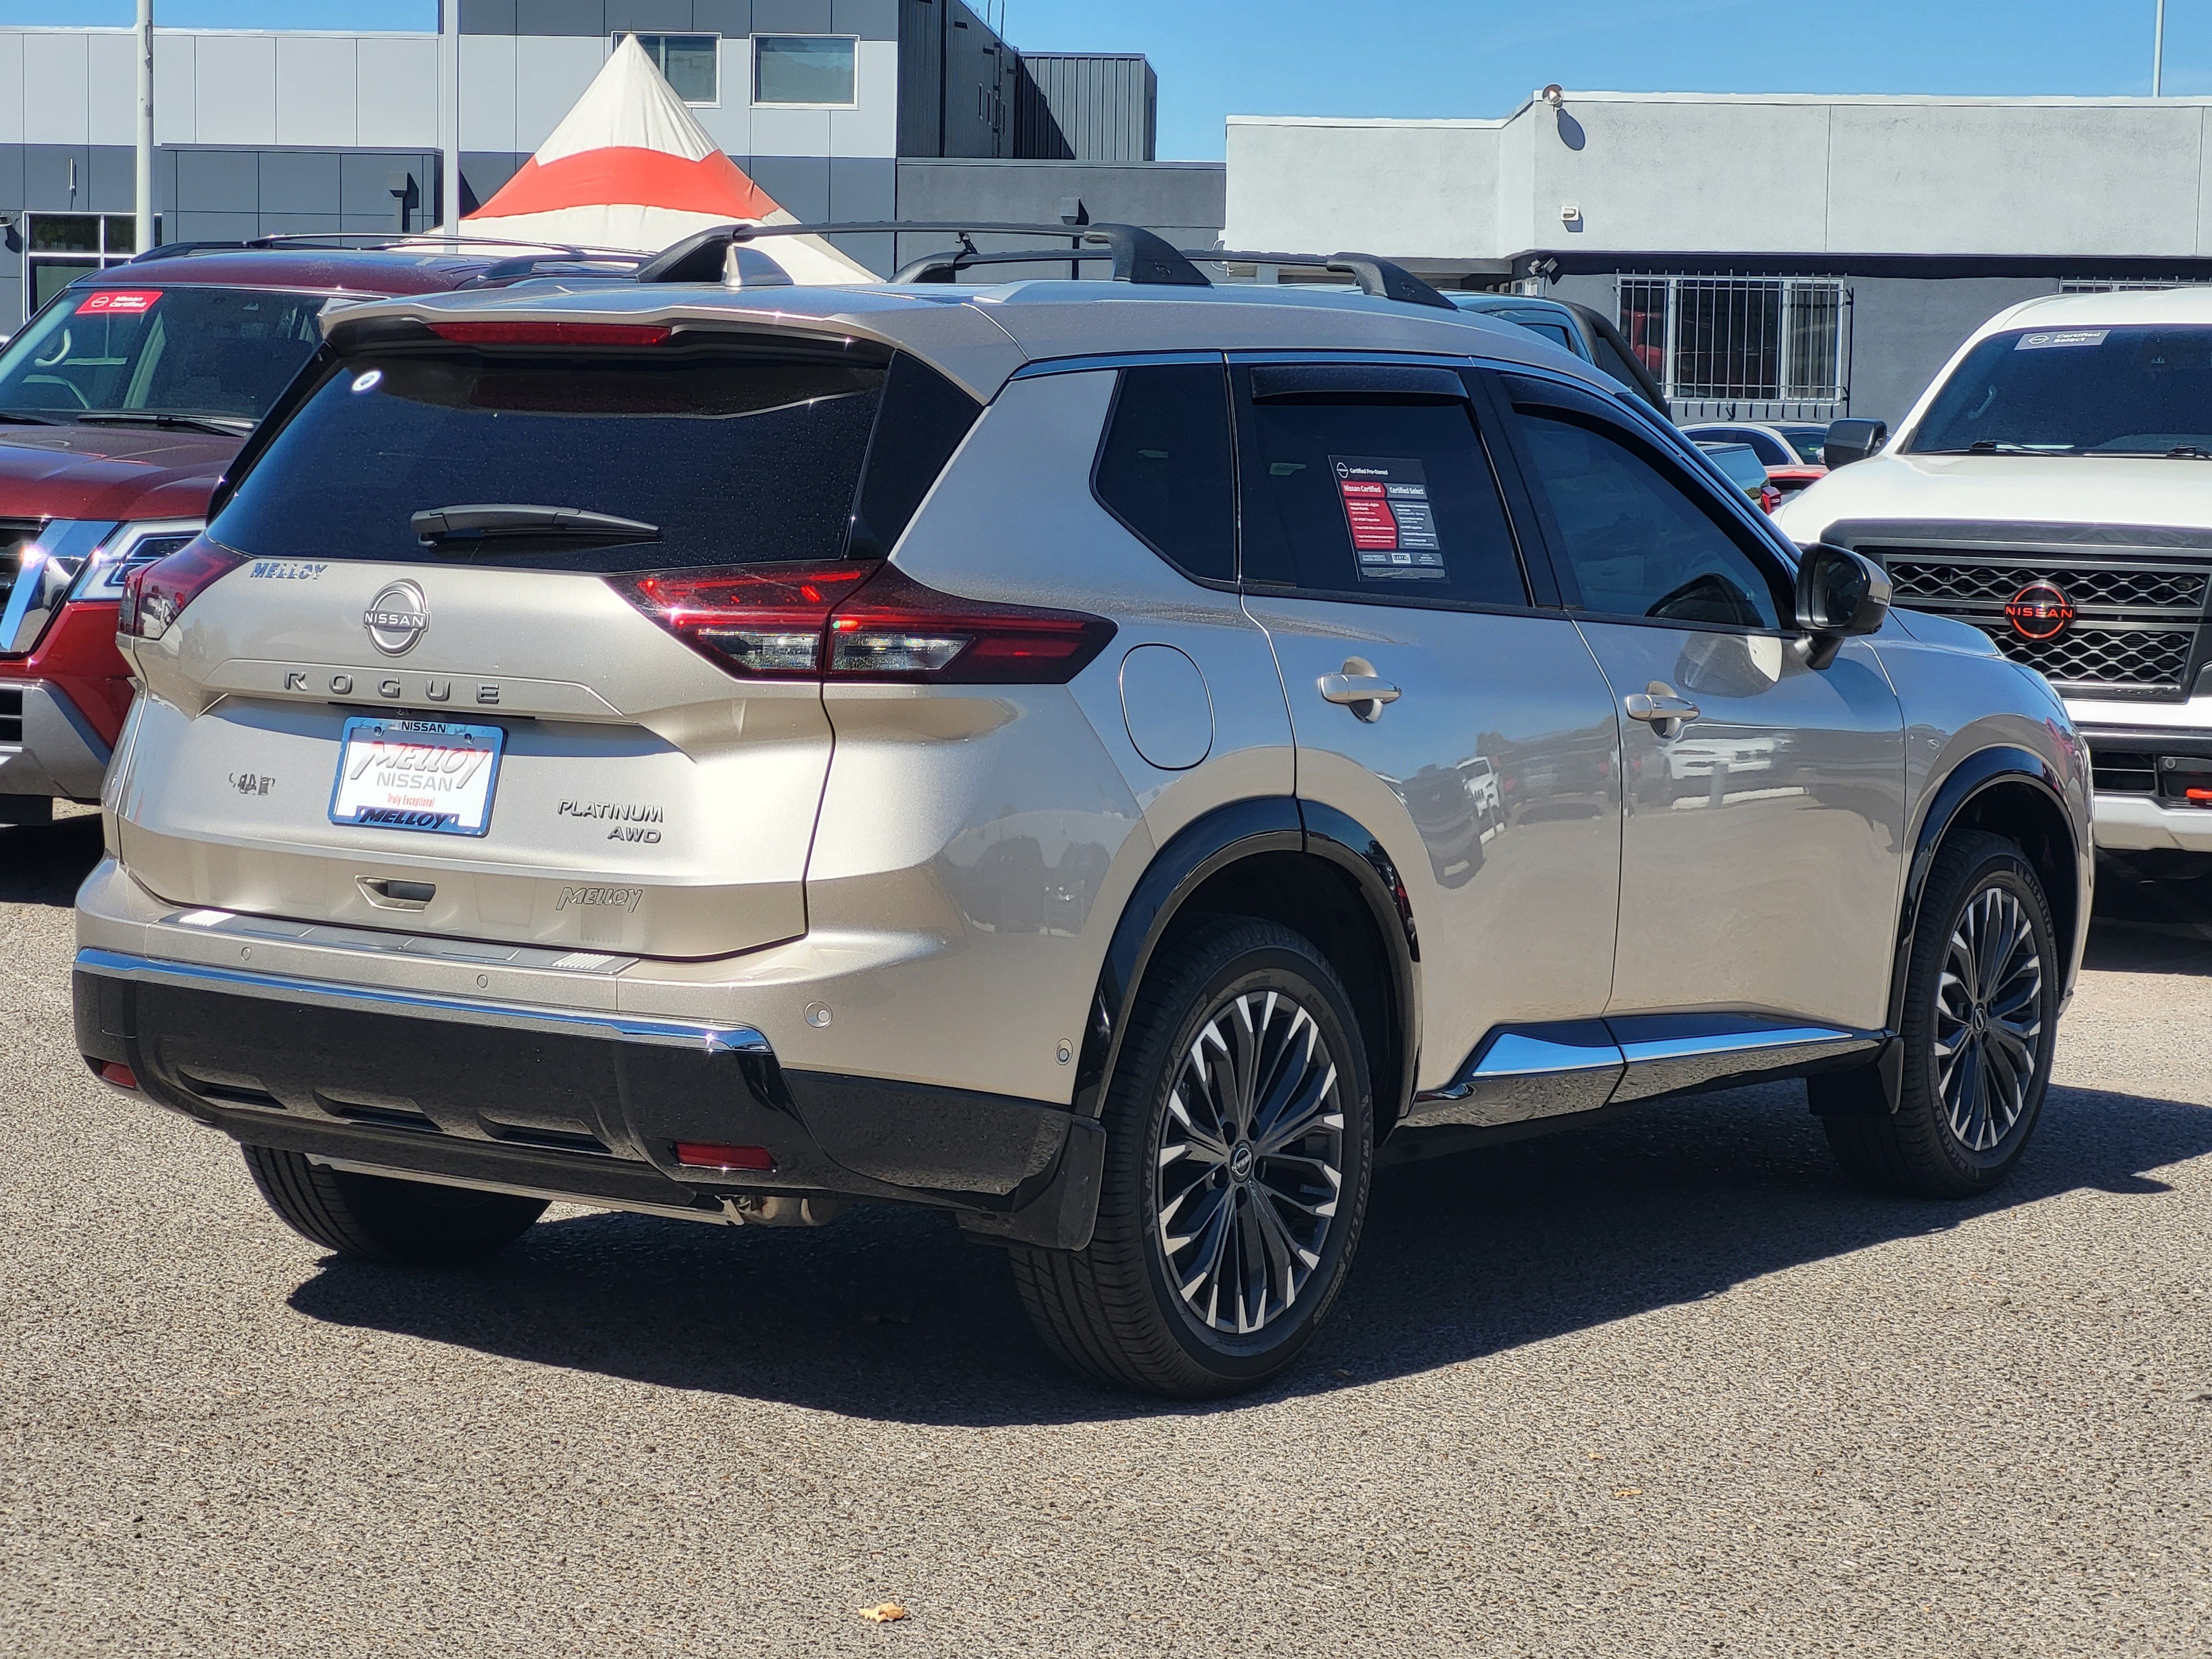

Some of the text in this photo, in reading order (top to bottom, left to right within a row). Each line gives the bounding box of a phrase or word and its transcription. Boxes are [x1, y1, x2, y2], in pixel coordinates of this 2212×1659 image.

[1360, 485, 1381, 493] Certified
[249, 562, 328, 580] MELLOY
[364, 612, 425, 627] NISSAN
[2005, 606, 2073, 619] NISSAN
[284, 669, 500, 705] ROGUE
[401, 721, 447, 733] NISSAN
[349, 740, 491, 789] MELLOY
[376, 771, 453, 792] NISSAN
[387, 793, 436, 808] Truly Exceptional
[358, 808, 451, 830] MELLOY
[557, 799, 664, 823] PLATINUM
[607, 826, 661, 844] AWD
[555, 887, 643, 914] MELLOY
